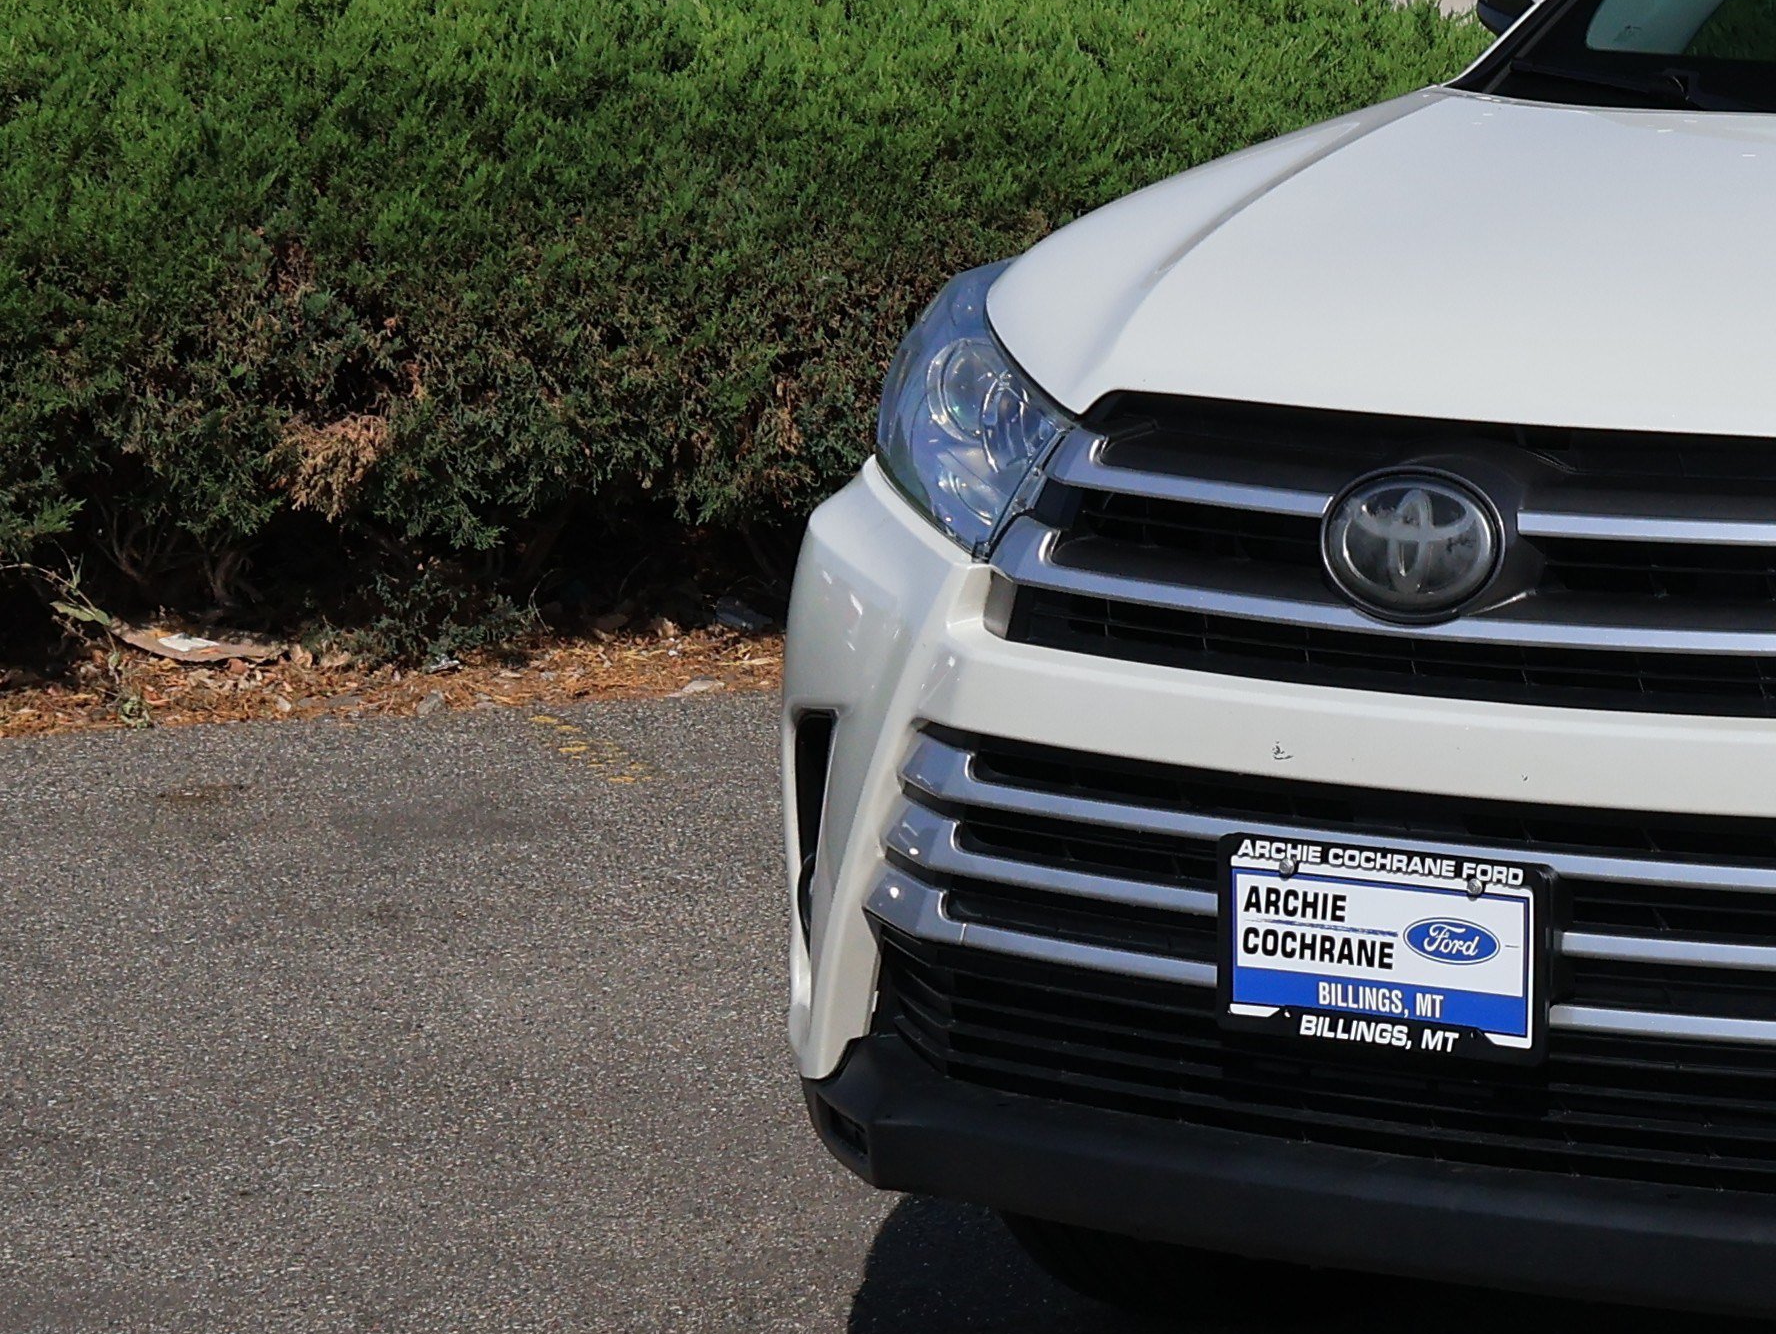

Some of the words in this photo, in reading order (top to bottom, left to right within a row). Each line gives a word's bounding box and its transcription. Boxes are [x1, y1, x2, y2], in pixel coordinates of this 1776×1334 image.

[1237, 839, 1322, 863] ARCHIE
[1328, 848, 1456, 877] COCHRANE
[1462, 862, 1524, 886] FORD
[1243, 885, 1347, 923] ARCHIE
[1242, 926, 1395, 970] COCHRANE
[1423, 923, 1480, 956] Ford
[1318, 981, 1409, 1019] BILLINGS,
[1415, 992, 1444, 1018] MT
[1299, 1014, 1412, 1050] BILLINGS,
[1420, 1028, 1460, 1053] MT
